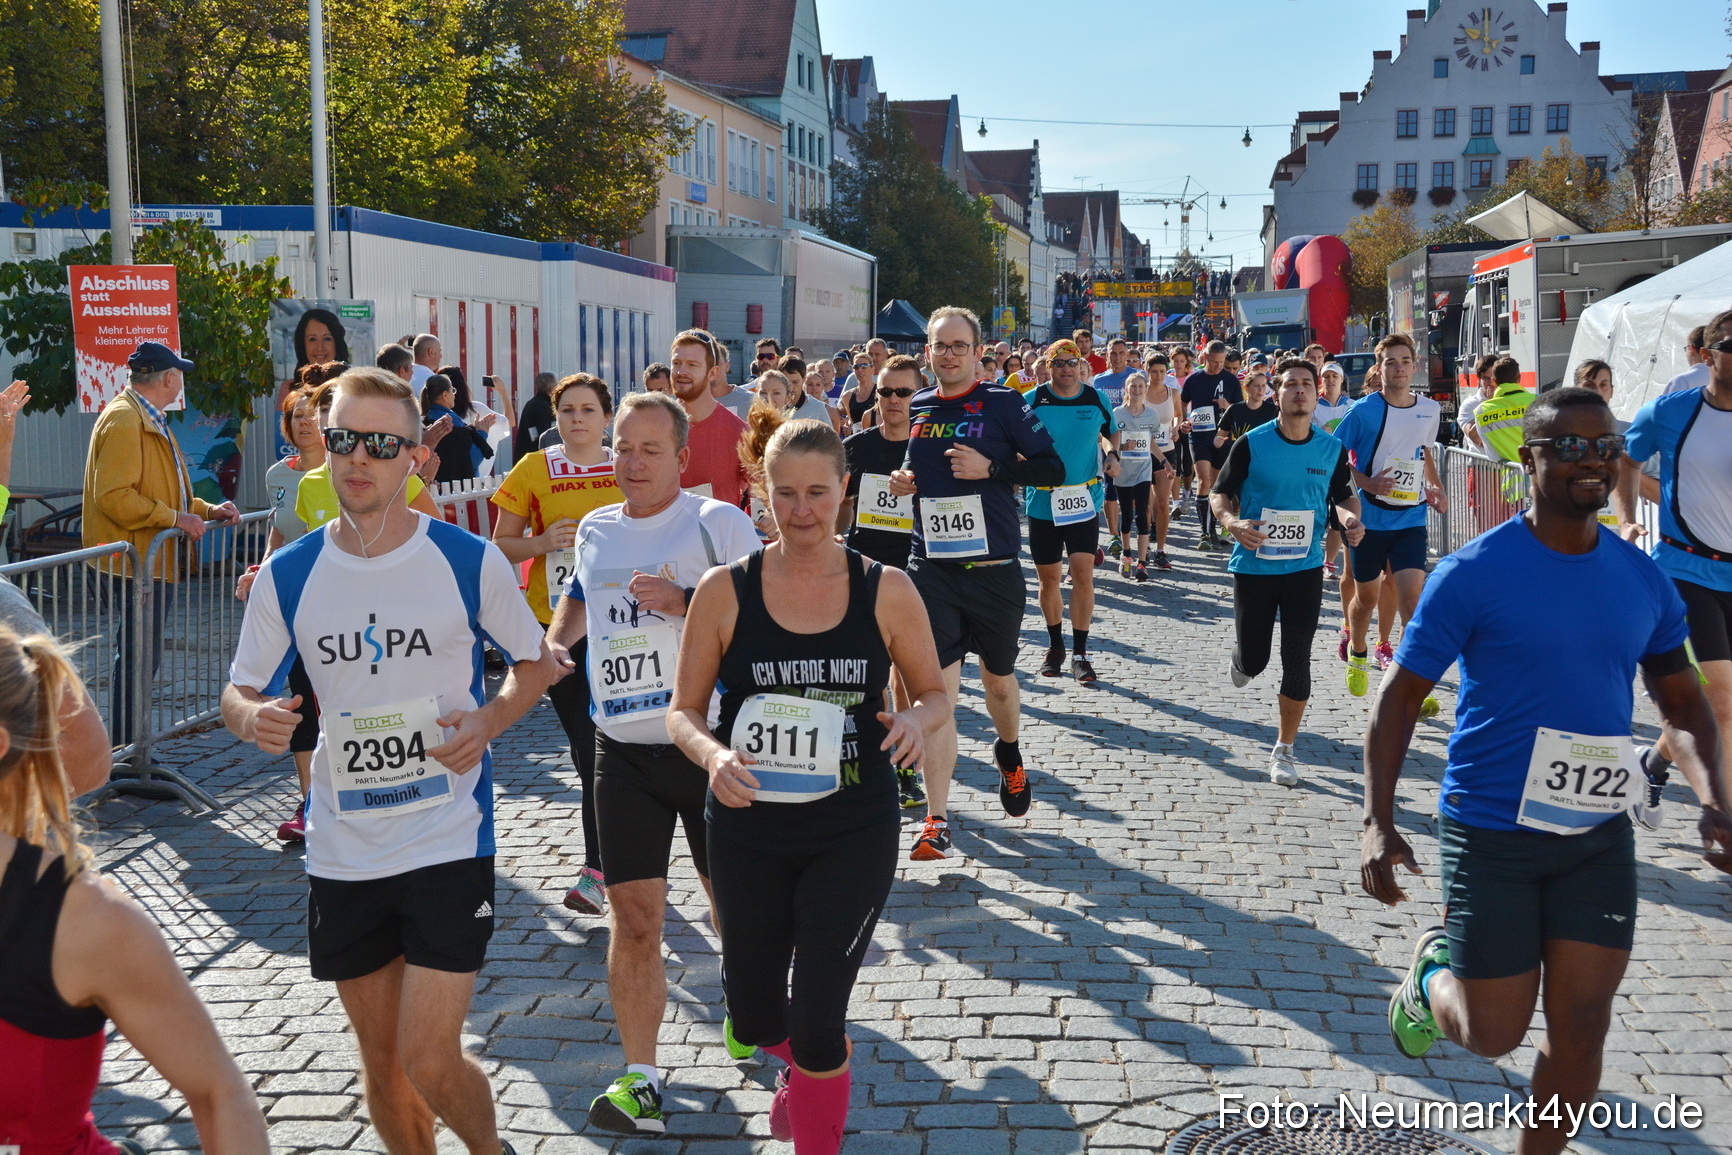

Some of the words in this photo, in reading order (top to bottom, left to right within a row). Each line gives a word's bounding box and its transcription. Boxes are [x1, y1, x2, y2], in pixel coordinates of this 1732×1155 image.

[1502, 21, 1515, 31] II
[80, 275, 170, 291] Abschluss
[1125, 285, 1159, 294] START
[80, 292, 110, 301] statt
[82, 303, 172, 316] Ausschluss!
[98, 326, 124, 334] Mehr
[126, 326, 156, 334] Lehrer
[157, 325, 169, 334] für
[95, 337, 132, 345] kleinere
[1193, 414, 1211, 422] 2386
[1483, 408, 1525, 422] Org.-Leit
[1126, 439, 1147, 448] 68
[1306, 467, 1327, 476] THULE
[1394, 470, 1414, 486] 275
[551, 481, 587, 494] MAX
[877, 490, 898, 509] 83
[936, 502, 962, 510] BOCK
[1058, 496, 1087, 511] 3035
[871, 516, 899, 526] Dominik
[930, 512, 975, 533] 3146
[1268, 524, 1305, 539] 2358
[317, 618, 432, 668] SUSPA
[609, 634, 648, 650] BOCK
[602, 650, 662, 686] 3071
[752, 662, 777, 686] ICH
[778, 659, 825, 685] WERDE
[830, 659, 868, 684] NICHT
[627, 684, 654, 692] Neumarkt
[764, 703, 811, 718] BOCK
[354, 713, 406, 730] BOCK
[746, 722, 819, 758] 3111
[343, 731, 426, 773] 2394
[840, 741, 858, 760] EIT
[1570, 743, 1618, 758] BOCK
[774, 760, 806, 770] Neumarkt
[380, 772, 414, 782] Neumarkt
[840, 762, 861, 786] N
[1546, 760, 1630, 797] 3122
[364, 785, 421, 806] Dominik
[1549, 795, 1575, 805] PARTL
[1576, 800, 1610, 808] Neumarkt
